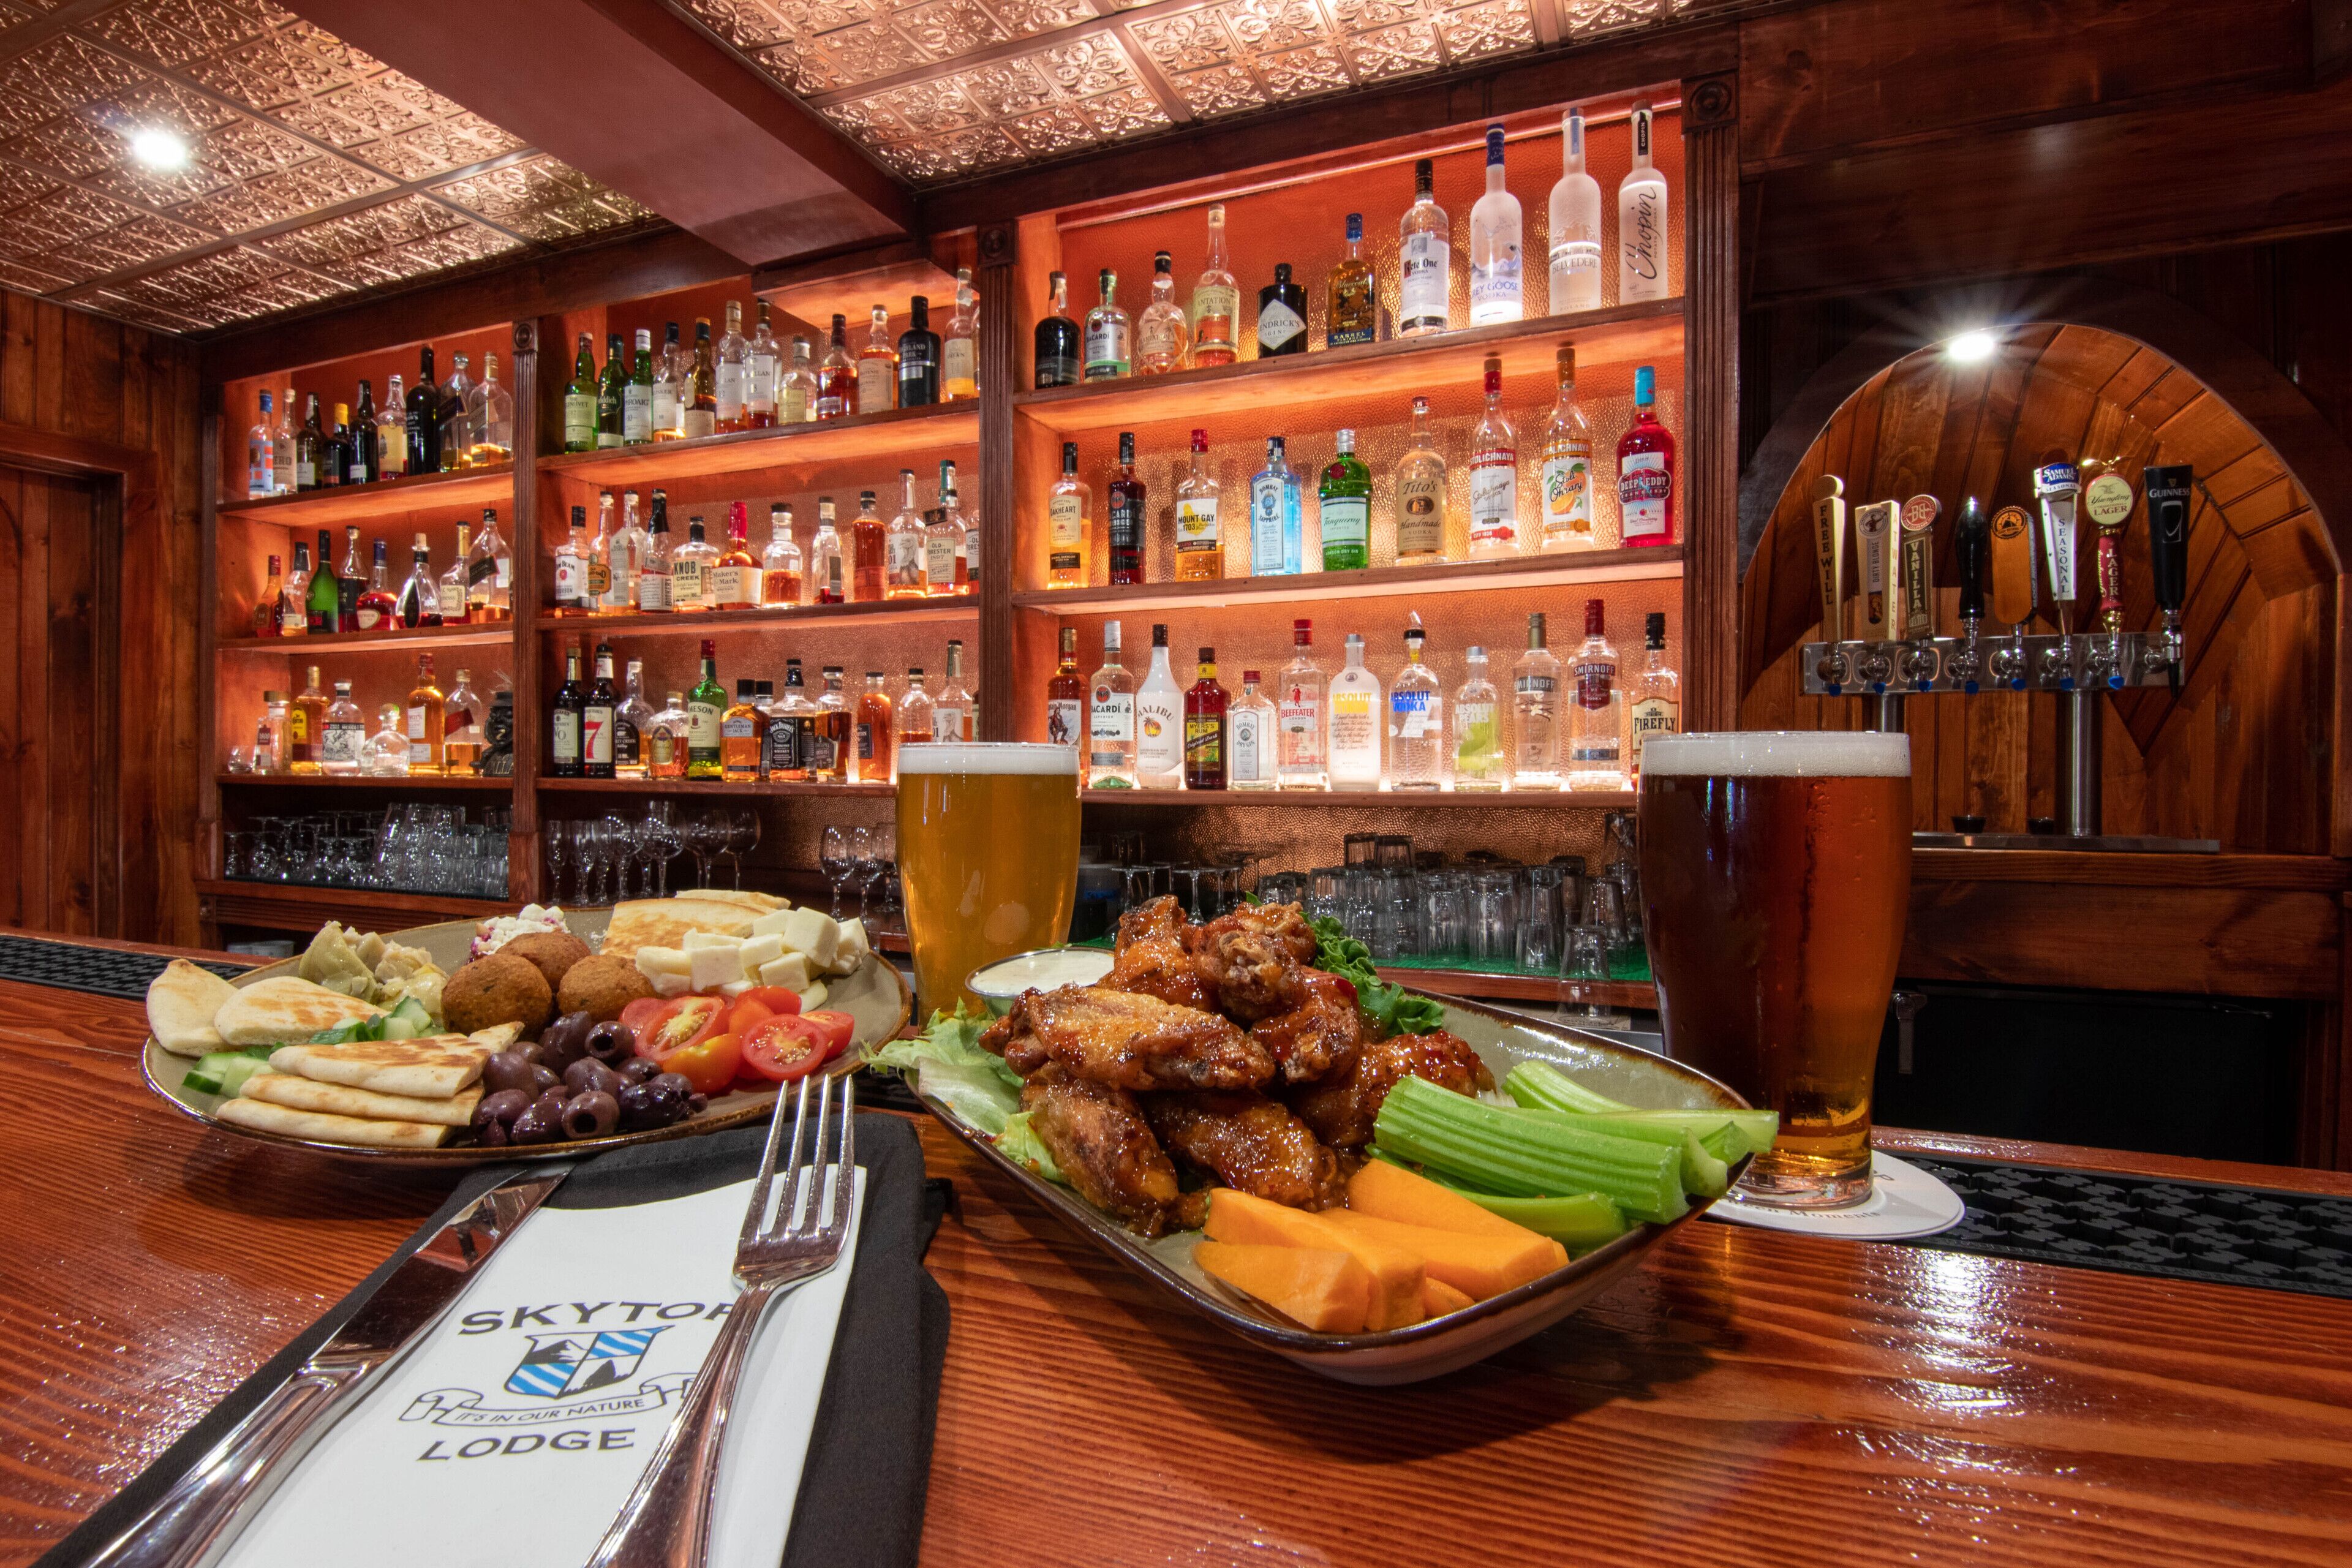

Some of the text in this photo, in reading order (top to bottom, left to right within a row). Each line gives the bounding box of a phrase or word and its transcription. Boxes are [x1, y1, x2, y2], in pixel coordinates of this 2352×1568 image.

[1625, 186, 1664, 279] Chopin
[1423, 258, 1438, 268] One
[1551, 257, 1597, 275] BELVEDERE
[1471, 281, 1518, 300] REY GOOSE
[1478, 292, 1507, 301] VODKA
[1259, 318, 1300, 332] ENDRICK'S
[1334, 331, 1365, 340] BARREL
[1470, 451, 1514, 466] STOLICHNAYA
[2044, 467, 2075, 478] SAMUEL
[2047, 474, 2075, 483] ADAMS
[1403, 480, 1438, 495] Tito's
[1621, 477, 1667, 492] DEEP EDDY
[2149, 488, 2190, 498] GUINNESS
[2089, 494, 2130, 505] Yuengling
[1050, 506, 1076, 516] OAKHEART
[2094, 506, 2128, 516] LAGER
[1178, 514, 1215, 525] MOUNT GAY
[1258, 512, 1280, 523] SAPPHIRE
[1324, 517, 1362, 527] Tanqueray
[1400, 518, 1441, 530] Handmade
[1820, 505, 1833, 605] FREE WILL
[1871, 541, 1880, 563] BLONDE
[2058, 518, 2069, 594] SEASONAL
[674, 561, 696, 575] KNOB
[2106, 549, 2119, 596] LAGER
[1910, 541, 1922, 609] VANILLA
[1574, 665, 1615, 676] SMIRNOFF
[1390, 690, 1430, 702] ABSOLUT
[689, 706, 714, 715] MESON
[1058, 702, 1077, 711] Morgan
[1392, 700, 1426, 712] VODKA
[1137, 705, 1174, 721] MALIBU
[1281, 708, 1314, 718] BEEFEATER
[770, 723, 779, 733] JACK
[1235, 722, 1256, 731] BOMBAY
[1634, 717, 1676, 734] FIREFLY
[584, 720, 603, 760] 7
[1236, 740, 1246, 748] DRY
[454, 1399, 646, 1422] IT'S IN OUR NATURE
[416, 1428, 636, 1461] LODGE
